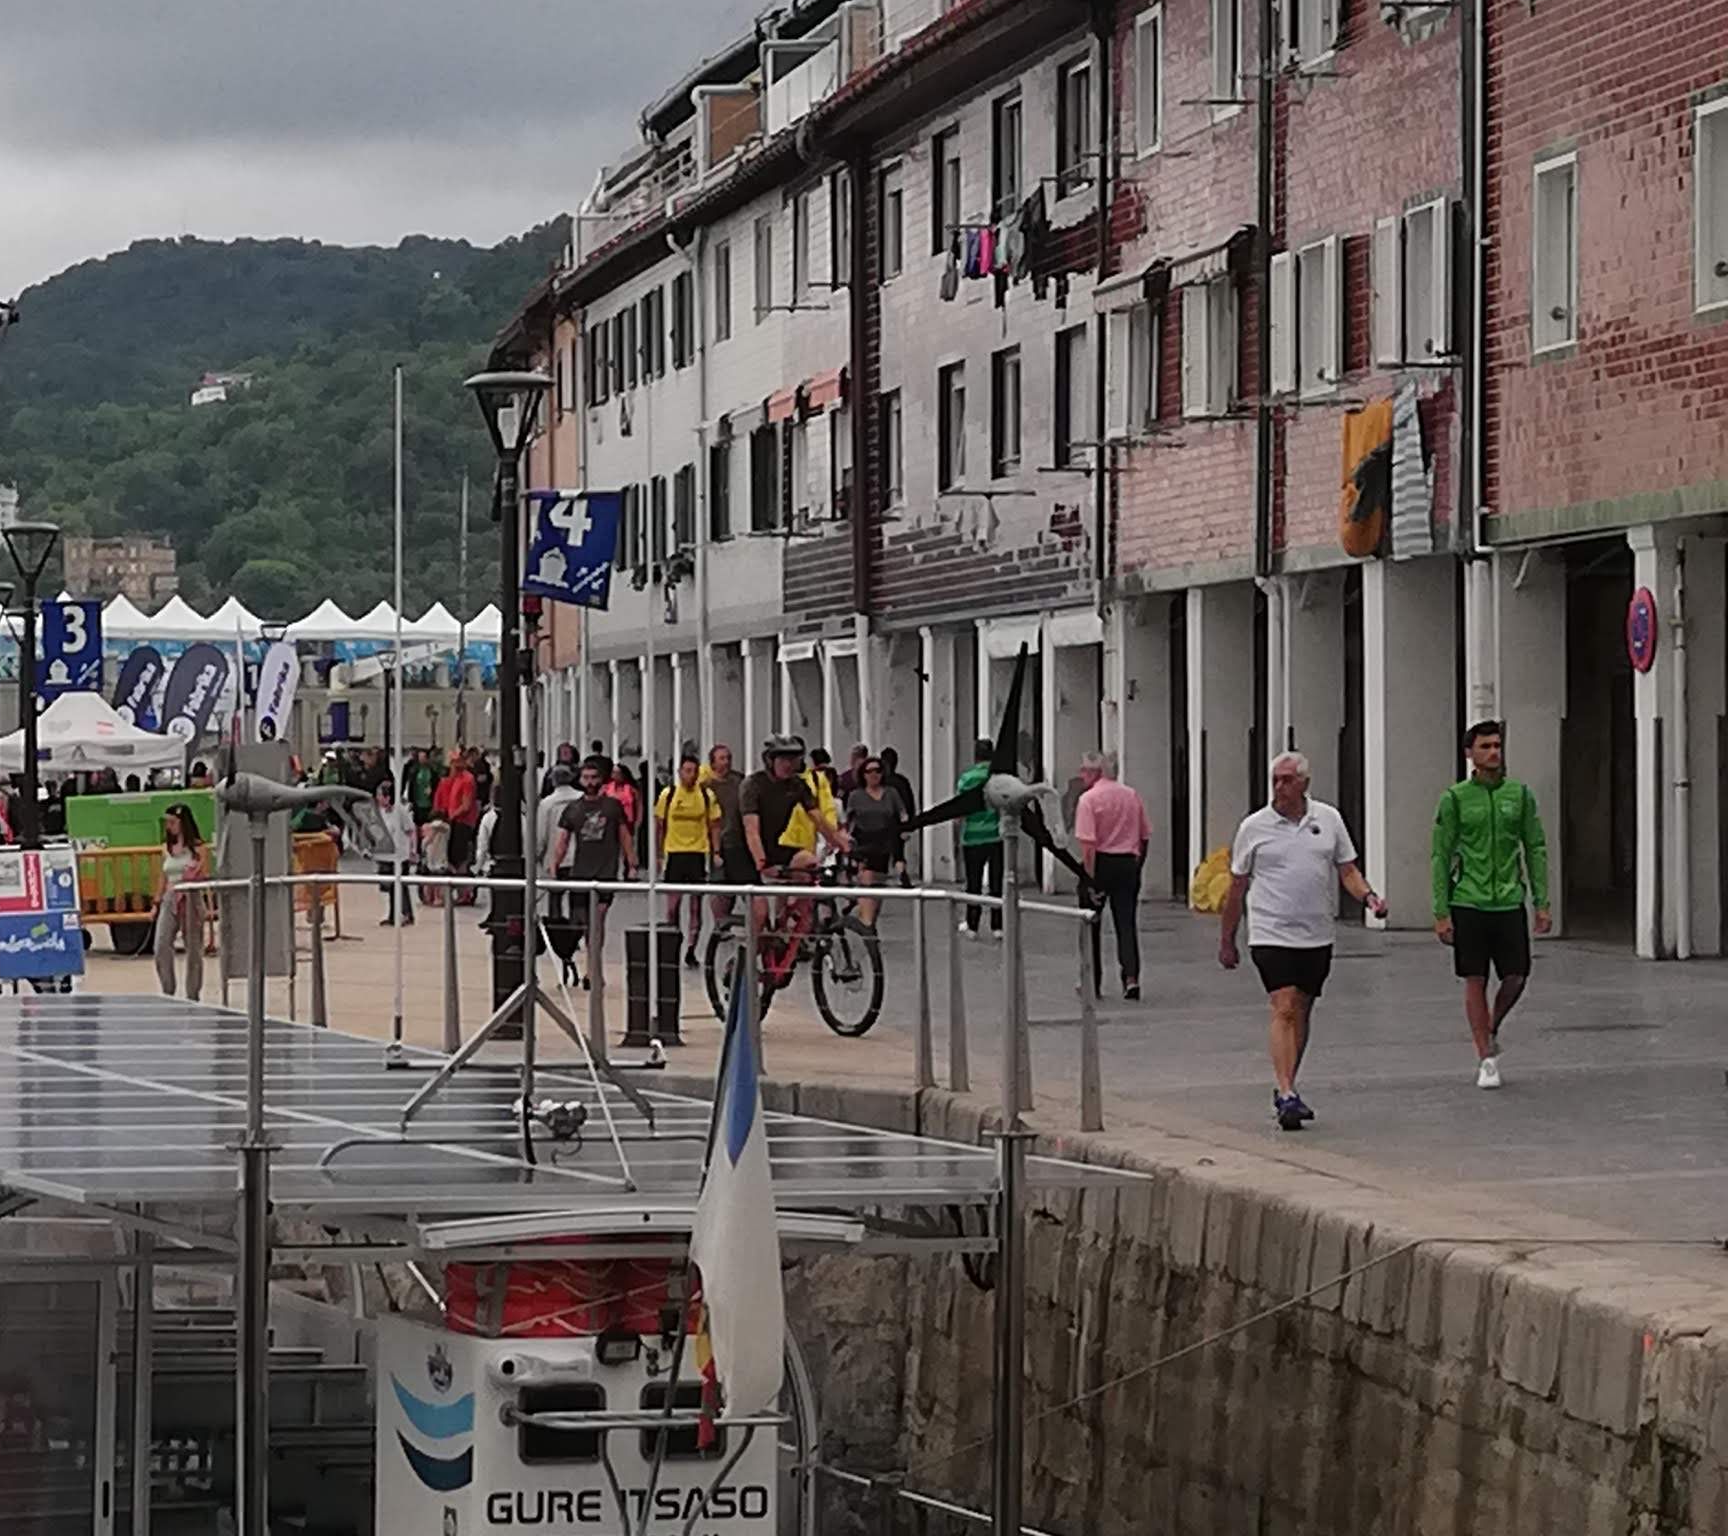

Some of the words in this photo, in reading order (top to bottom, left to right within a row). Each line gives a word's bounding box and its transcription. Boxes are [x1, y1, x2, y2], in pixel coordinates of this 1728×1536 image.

[549, 498, 593, 546] 4
[61, 606, 88, 654] 3
[486, 1488, 602, 1524] GURE
